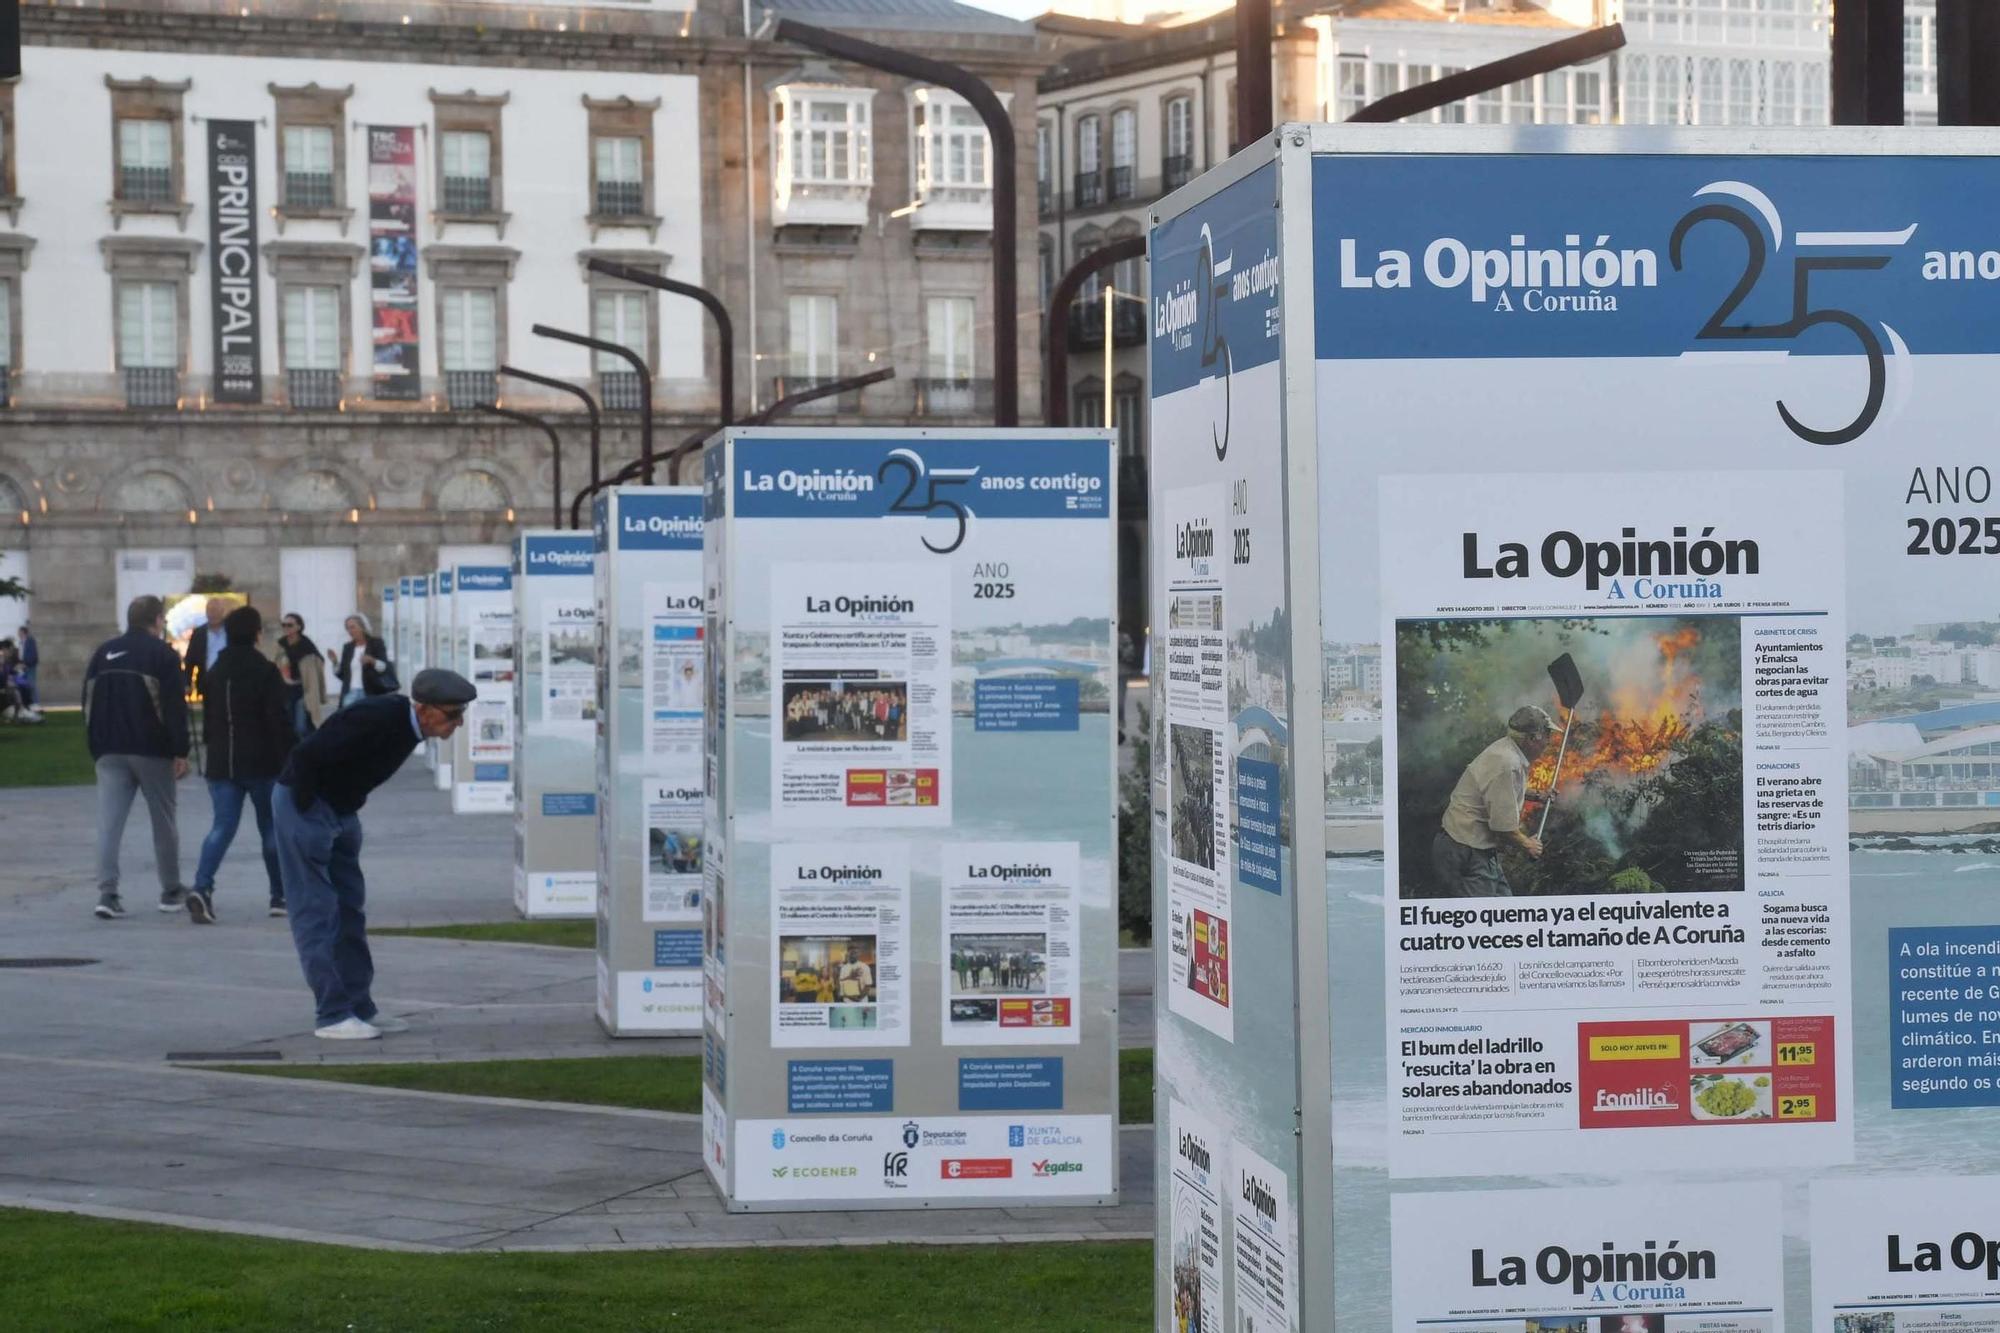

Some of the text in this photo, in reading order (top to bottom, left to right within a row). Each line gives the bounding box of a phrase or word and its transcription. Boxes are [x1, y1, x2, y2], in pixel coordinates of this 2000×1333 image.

[217, 164, 253, 352] PRINCIPAL
[1155, 296, 1166, 338] La
[1166, 279, 1197, 344] Opinión
[1232, 266, 1250, 302] anos
[1494, 288, 1618, 313] A Coruña
[1339, 238, 1411, 289] La
[1424, 235, 1658, 303] Opinión
[1669, 180, 1917, 445] 25
[1905, 466, 1991, 504] ANO
[744, 448, 1101, 554] La Opinión 25 anos contigo
[818, 490, 857, 501] Coruña
[1232, 479, 1247, 516] ANO
[624, 516, 704, 536] La Opinió
[1176, 518, 1214, 568] La Opinión
[1907, 517, 2000, 555] 2025
[1233, 528, 1250, 565] 2025
[530, 551, 546, 563] La
[1462, 527, 1760, 590] La Opinión
[973, 562, 1009, 579] ANO
[973, 583, 1015, 599] 2025
[1607, 575, 1723, 600] A Coruña
[666, 596, 685, 609] La
[806, 595, 914, 617] La Opinión
[1754, 643, 1824, 653] Ayuntamientos
[1755, 655, 1798, 665] y Emalcsa
[1755, 665, 1808, 676] negocian las
[1755, 677, 1828, 687] obras para evitar
[1755, 688, 1818, 698] cortes de agua
[1756, 777, 1822, 786] El verano abre
[659, 788, 675, 799] La
[1775, 788, 1803, 799] grieta
[1757, 799, 1824, 809] las reservas de
[1757, 810, 1821, 821] sangre: «Es un
[1757, 821, 1816, 831] tetris diario»
[798, 865, 882, 883] La Opinión
[968, 864, 1052, 881] La Opinión
[1400, 900, 1729, 928] El fuego quema ya el equivalente a
[1763, 903, 1828, 914] Sogama busca
[1780, 916, 1809, 924] nueva
[1810, 914, 1830, 923] vida
[1400, 924, 1745, 951] cuatro veces el tamaño de A Coruña
[1772, 926, 1785, 935] las
[1786, 925, 1827, 935] escorias:
[1761, 937, 1831, 947] desde cemento
[1900, 942, 1911, 956] A
[1916, 942, 1939, 956] ola
[1784, 948, 1816, 957] asfalto
[1900, 963, 1986, 979] constitúe a
[1901, 986, 1983, 1001] recente de
[1901, 1009, 1973, 1024] lumes de
[1435, 1025, 1483, 1033] INMOBILIARIO
[1902, 1031, 1976, 1046] climático.
[1401, 1037, 1543, 1057] El bum del ladrillo
[1478, 1060, 1492, 1075] la
[1495, 1059, 1533, 1074] obra
[1535, 1061, 1555, 1073] en
[1902, 1054, 1962, 1069] arderon
[1402, 1078, 1572, 1098] solares abandonados
[1902, 1076, 1991, 1094] segundo os
[790, 1134, 827, 1142] Concello
[841, 1133, 873, 1141] Coruña
[923, 1130, 967, 1139] Deputación
[1027, 1126, 1062, 1135] XUNTA
[1026, 1136, 1083, 1146] DE GALICIA
[1178, 1127, 1211, 1174] La Opinión
[792, 1167, 857, 1177] ECOENER
[1032, 1159, 1083, 1176] Vegalsa
[1242, 1168, 1277, 1223] La Opinión
[1887, 1235, 1942, 1273] La
[1471, 1240, 1716, 1295] La Opinión
[1591, 1283, 1685, 1302] A Coruña
